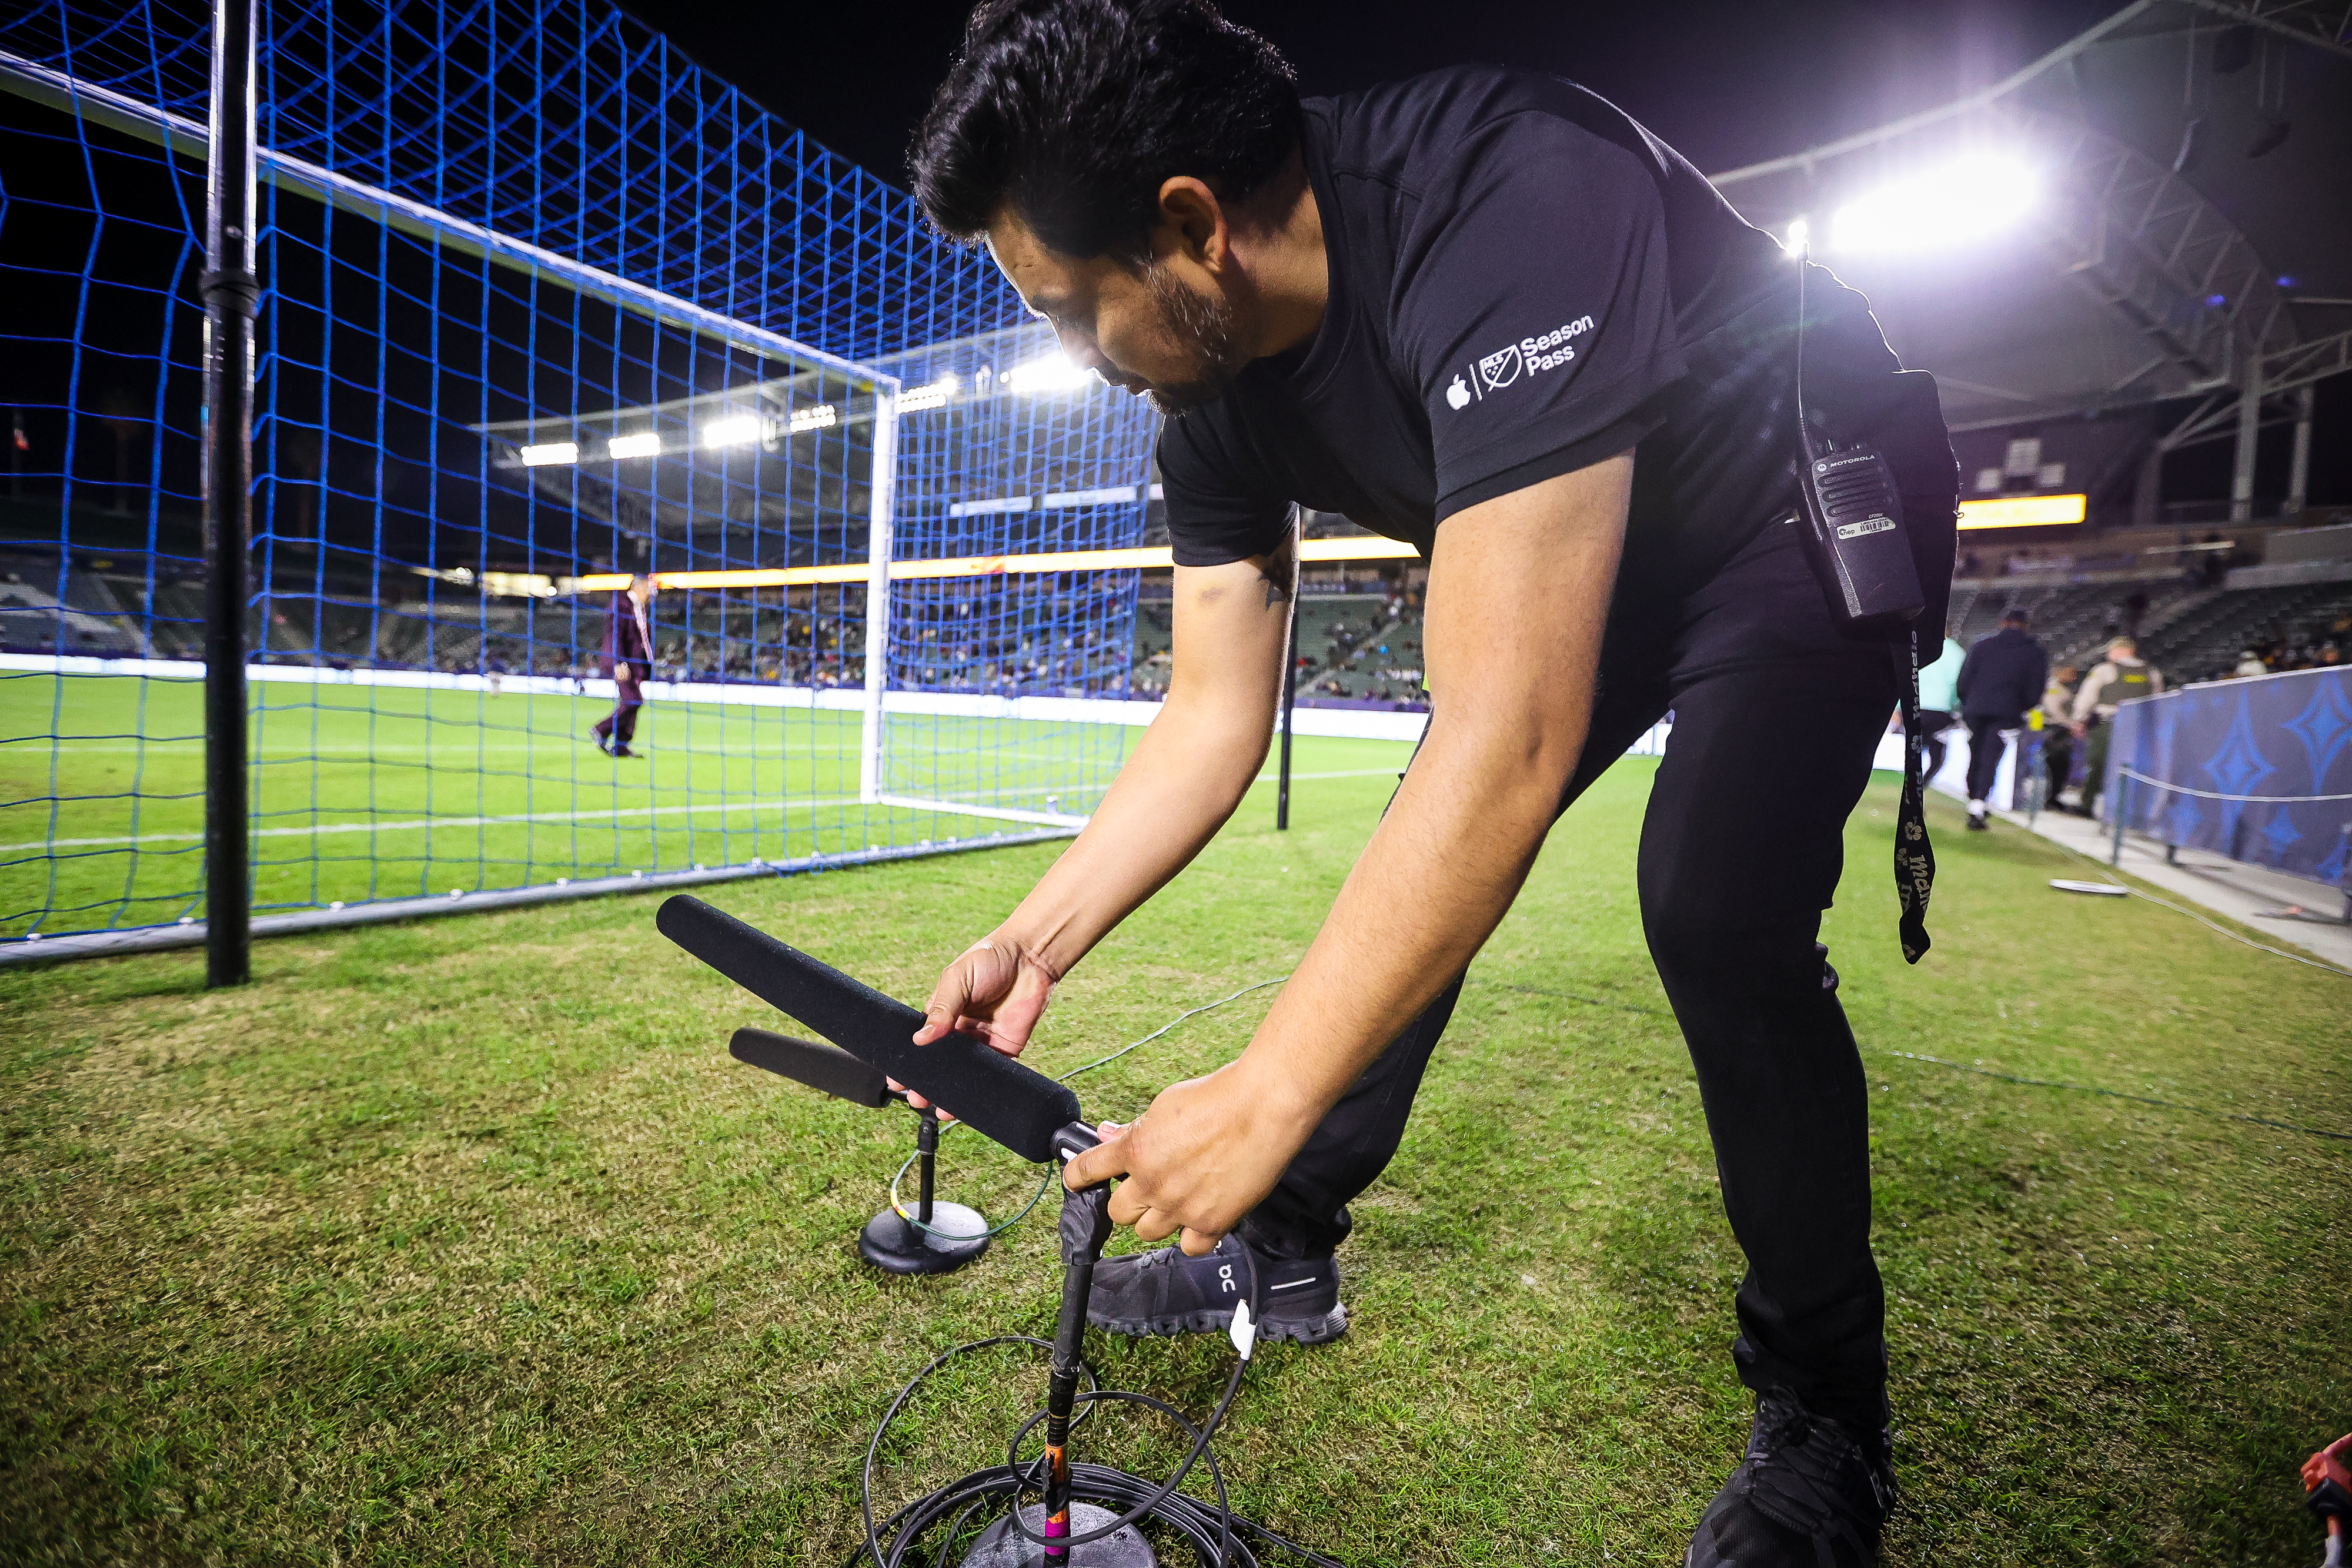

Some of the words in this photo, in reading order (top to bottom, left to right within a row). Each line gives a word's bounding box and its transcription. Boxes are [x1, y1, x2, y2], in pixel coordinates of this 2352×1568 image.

[1521, 315, 1595, 357] Season
[1484, 353, 1504, 370] MLS
[1525, 345, 1575, 377] Pass
[1830, 455, 1875, 468] MOTOROLA
